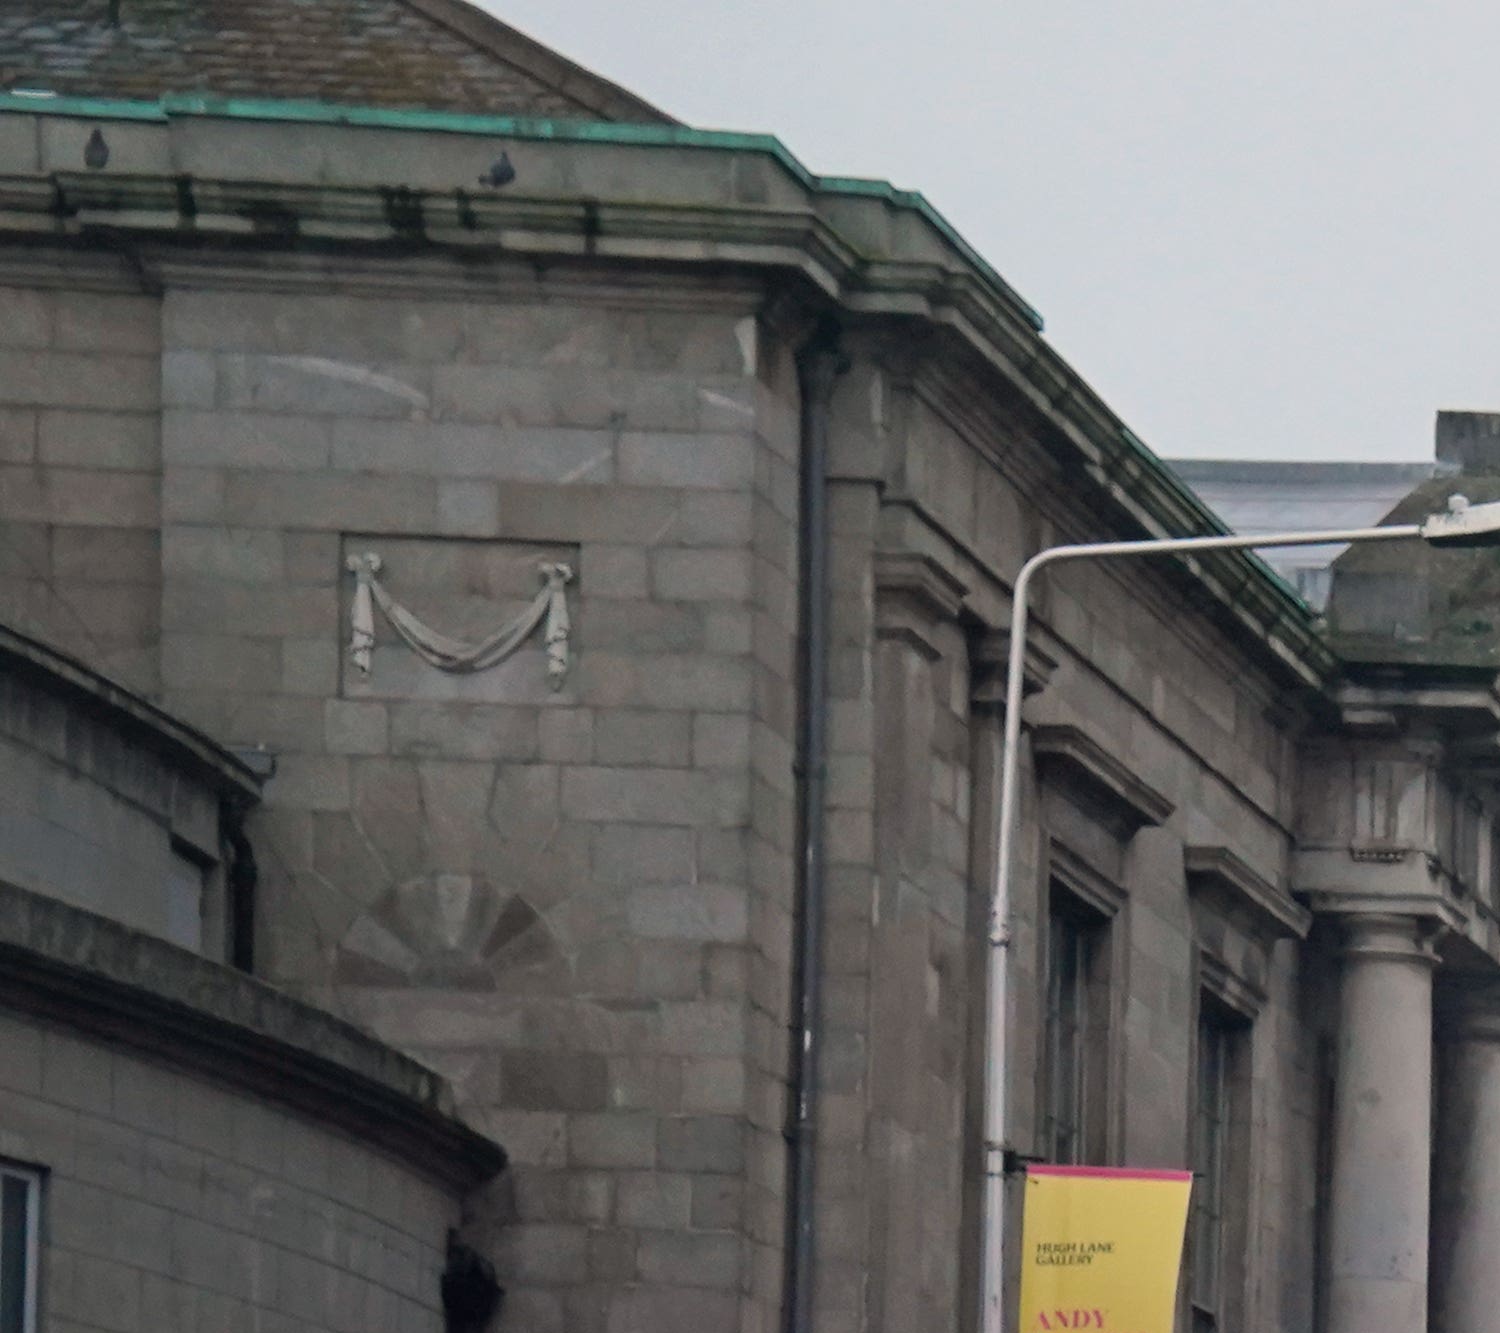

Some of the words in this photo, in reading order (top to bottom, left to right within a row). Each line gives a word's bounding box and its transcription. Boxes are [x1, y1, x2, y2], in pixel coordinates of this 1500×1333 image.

[1036, 1243, 1076, 1253] HUGH
[1080, 1242, 1114, 1253] LANE
[1036, 1255, 1093, 1266] GALLERY
[1034, 1309, 1108, 1330] ANDY
